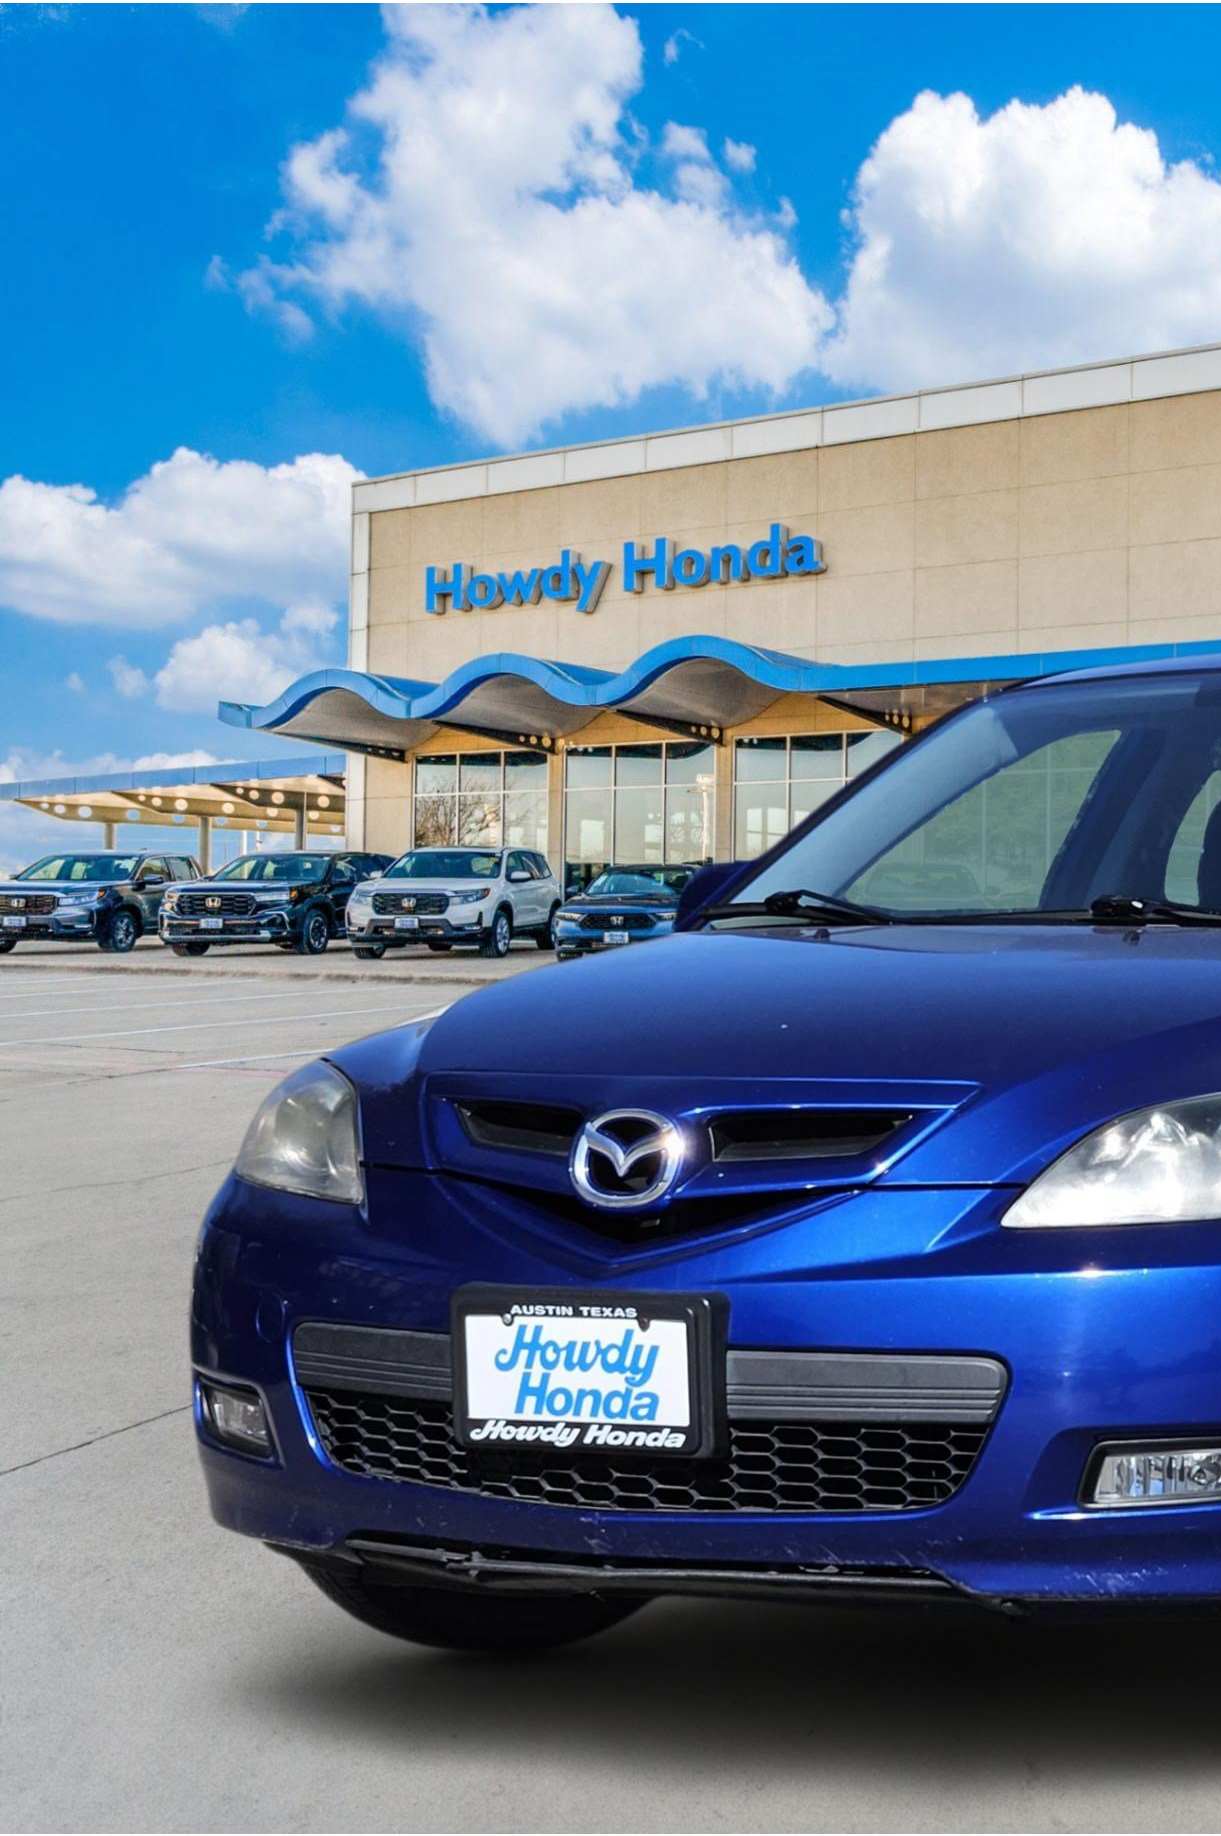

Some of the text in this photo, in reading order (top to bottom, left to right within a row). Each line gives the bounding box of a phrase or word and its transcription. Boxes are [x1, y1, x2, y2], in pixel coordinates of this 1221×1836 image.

[425, 523, 828, 615] Howdy Honda
[510, 1304, 638, 1318] AUSTIN TEXAS
[494, 1324, 660, 1388] Howdy
[514, 1371, 661, 1421] Honda
[470, 1419, 687, 1448] Howdy Honda
